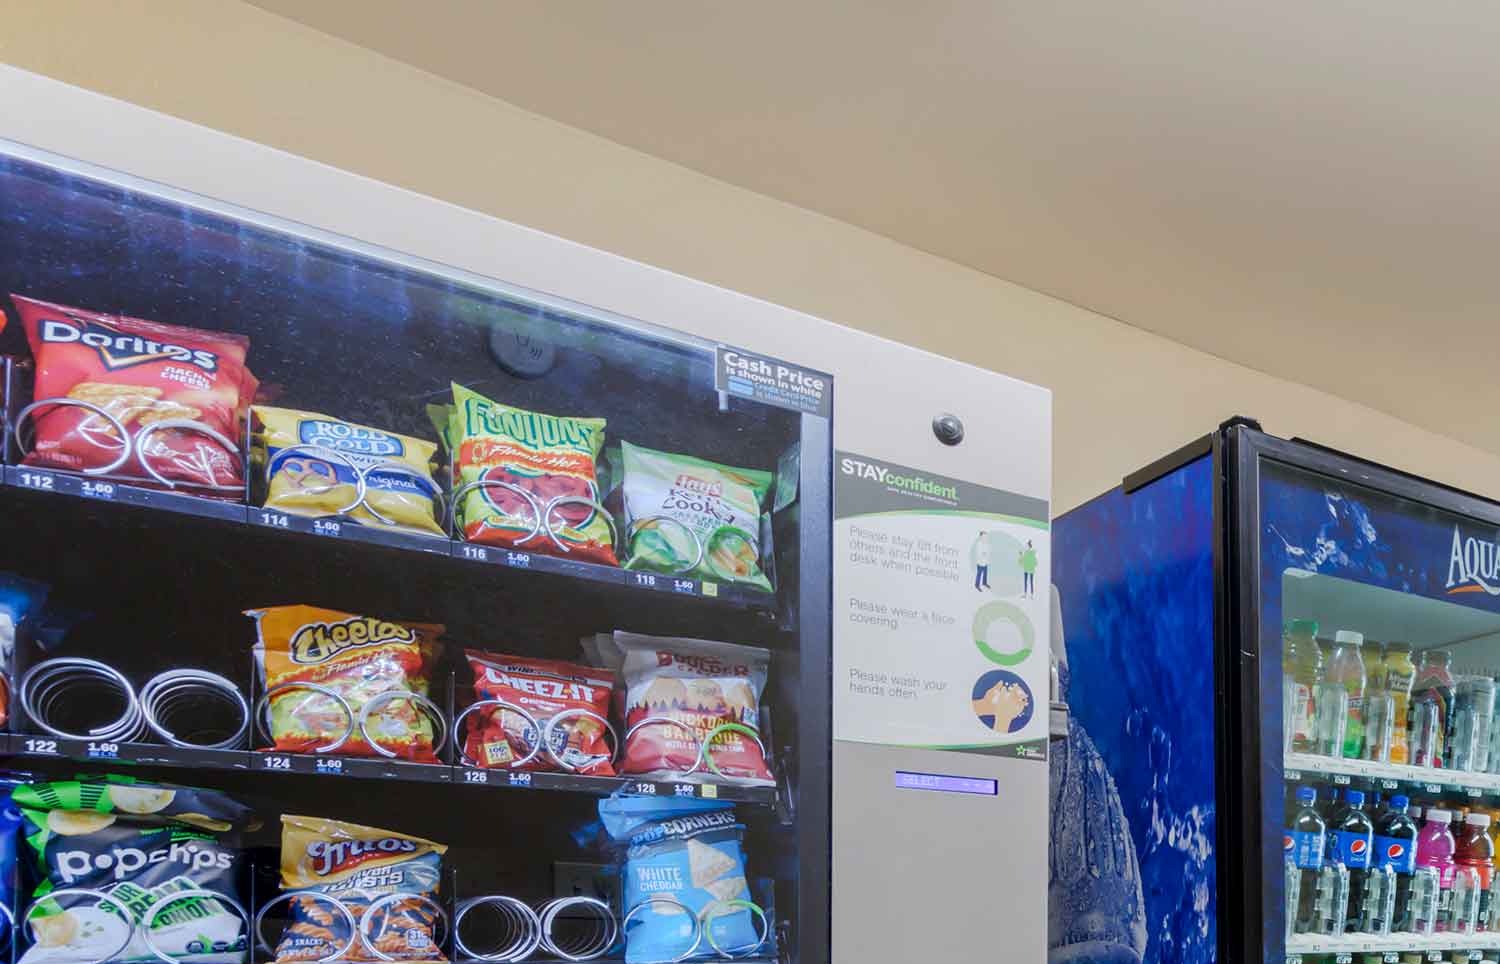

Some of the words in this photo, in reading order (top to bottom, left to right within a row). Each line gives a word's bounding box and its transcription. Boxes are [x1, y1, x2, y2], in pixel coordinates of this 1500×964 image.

[42, 321, 216, 369] Doritos
[724, 352, 772, 376] Cash
[777, 366, 824, 390] Price
[737, 369, 776, 385] shown
[791, 382, 822, 399] white
[312, 421, 386, 440] ROLD
[465, 400, 594, 450] FUNYUNS
[310, 436, 395, 455] GOLD
[21, 473, 53, 488] 112
[262, 513, 288, 528] 114
[463, 548, 486, 560] 116
[636, 574, 655, 585] 118
[850, 613, 898, 630] covering
[293, 618, 412, 662] Cheetos
[850, 668, 887, 684] Please
[892, 675, 920, 688] wash
[923, 679, 948, 692] your
[849, 681, 884, 696] hands
[25, 740, 57, 753] 122
[264, 757, 290, 769] 124
[464, 772, 487, 782] 126
[636, 784, 655, 794] 128
[56, 843, 234, 881] popchips
[307, 838, 416, 876] Fritos
[637, 867, 681, 880] WHITE
[639, 879, 683, 892] CHEDDAR
